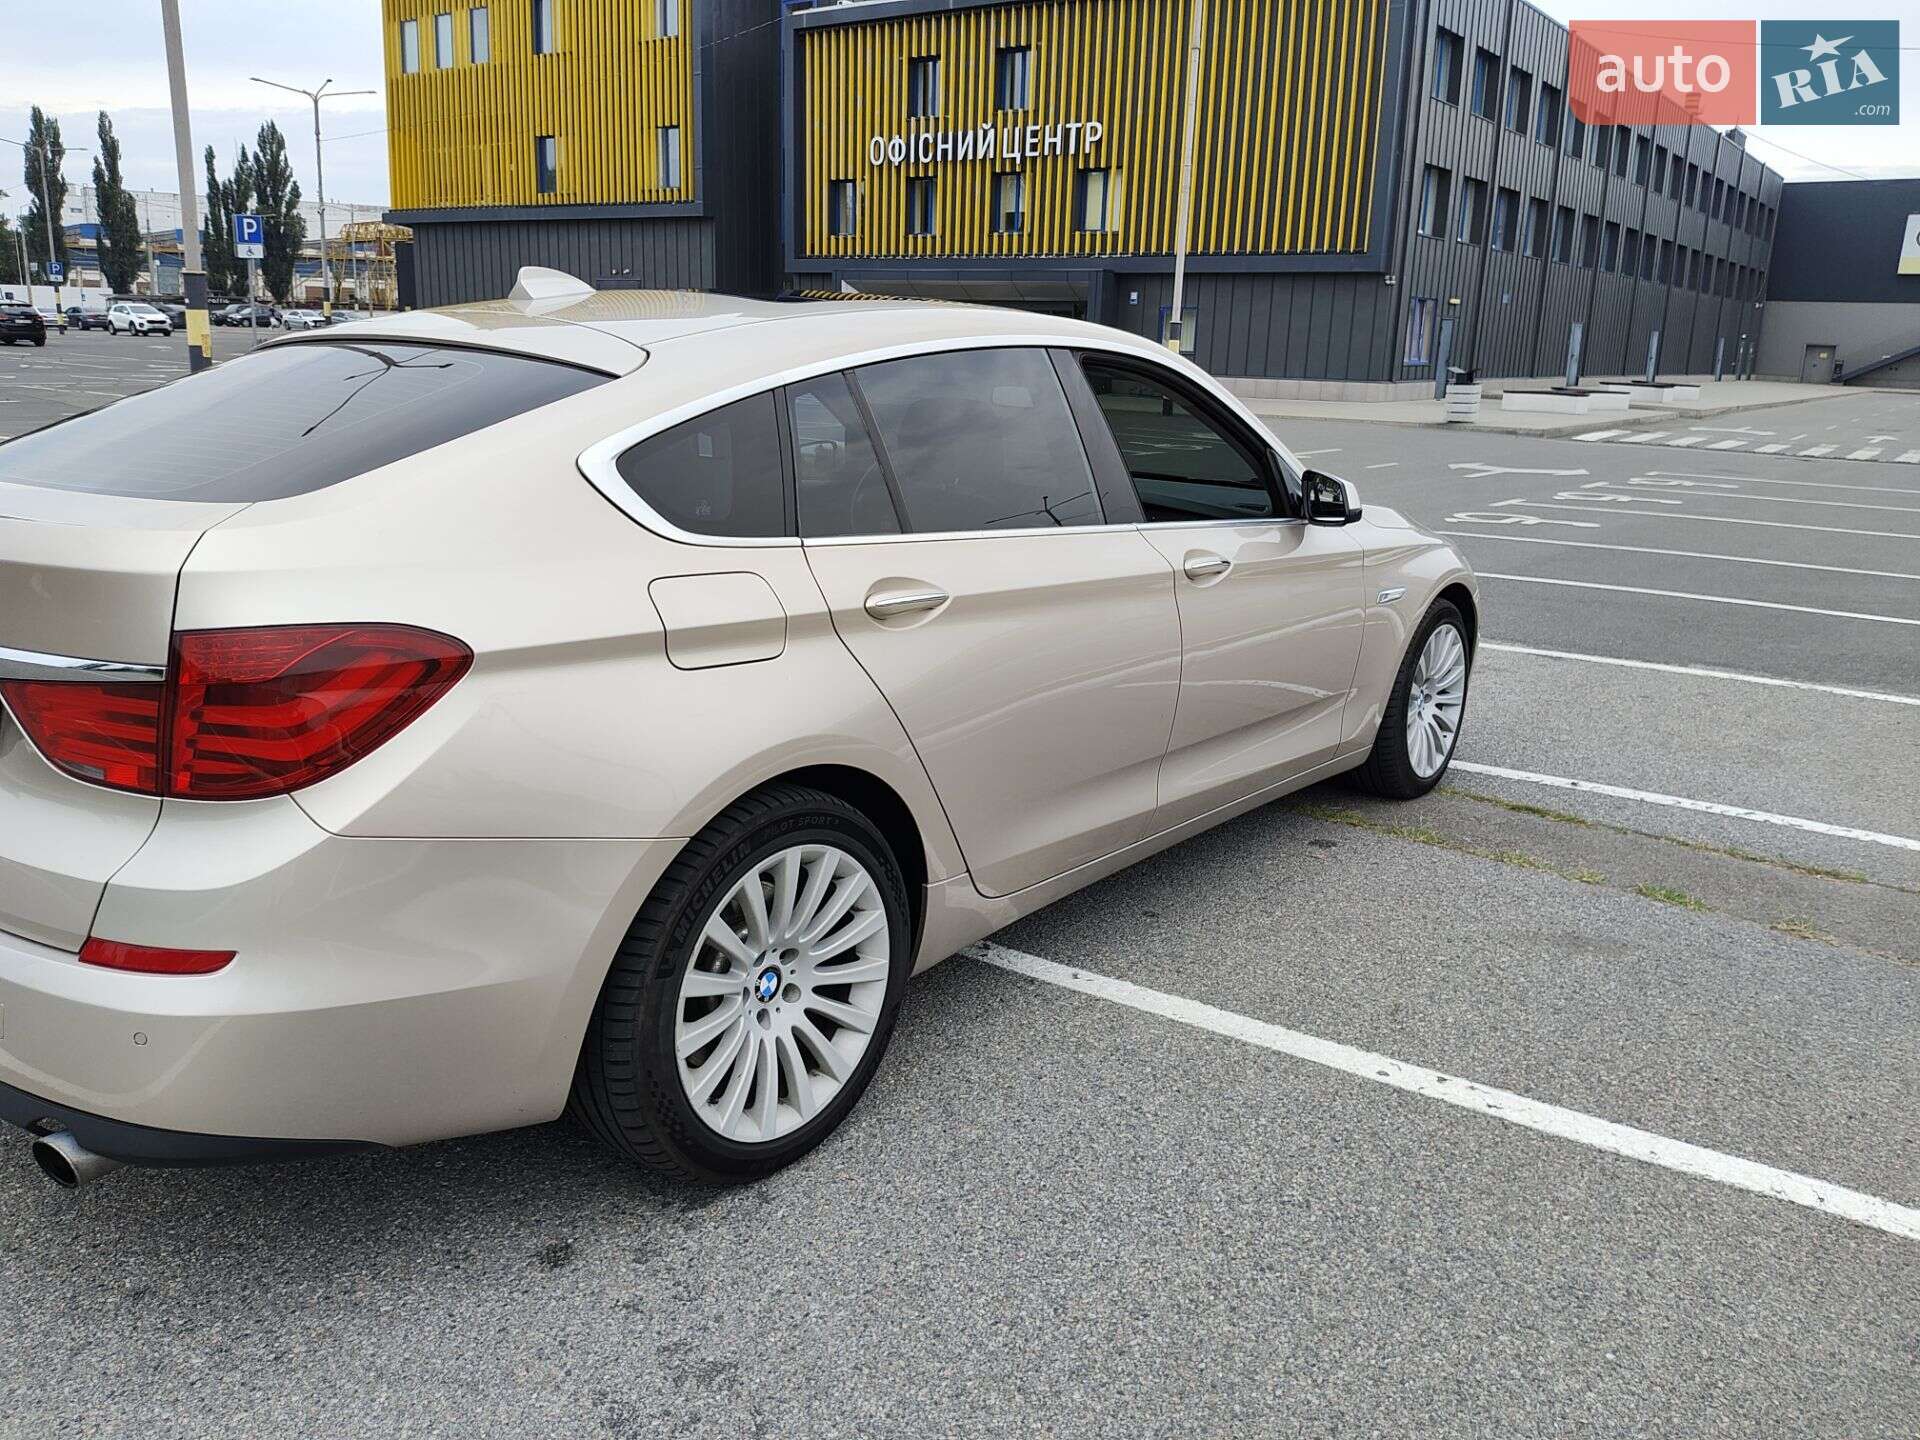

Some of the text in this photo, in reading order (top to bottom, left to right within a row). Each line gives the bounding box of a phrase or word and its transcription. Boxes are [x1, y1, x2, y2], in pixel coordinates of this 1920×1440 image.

[869, 121, 1103, 167] ОФІСНИЙ ЦЕНТР
[243, 218, 257, 240] P
[52, 263, 60, 273] P
[673, 838, 752, 945] MICHELIN
[799, 815, 834, 827] SPORT
